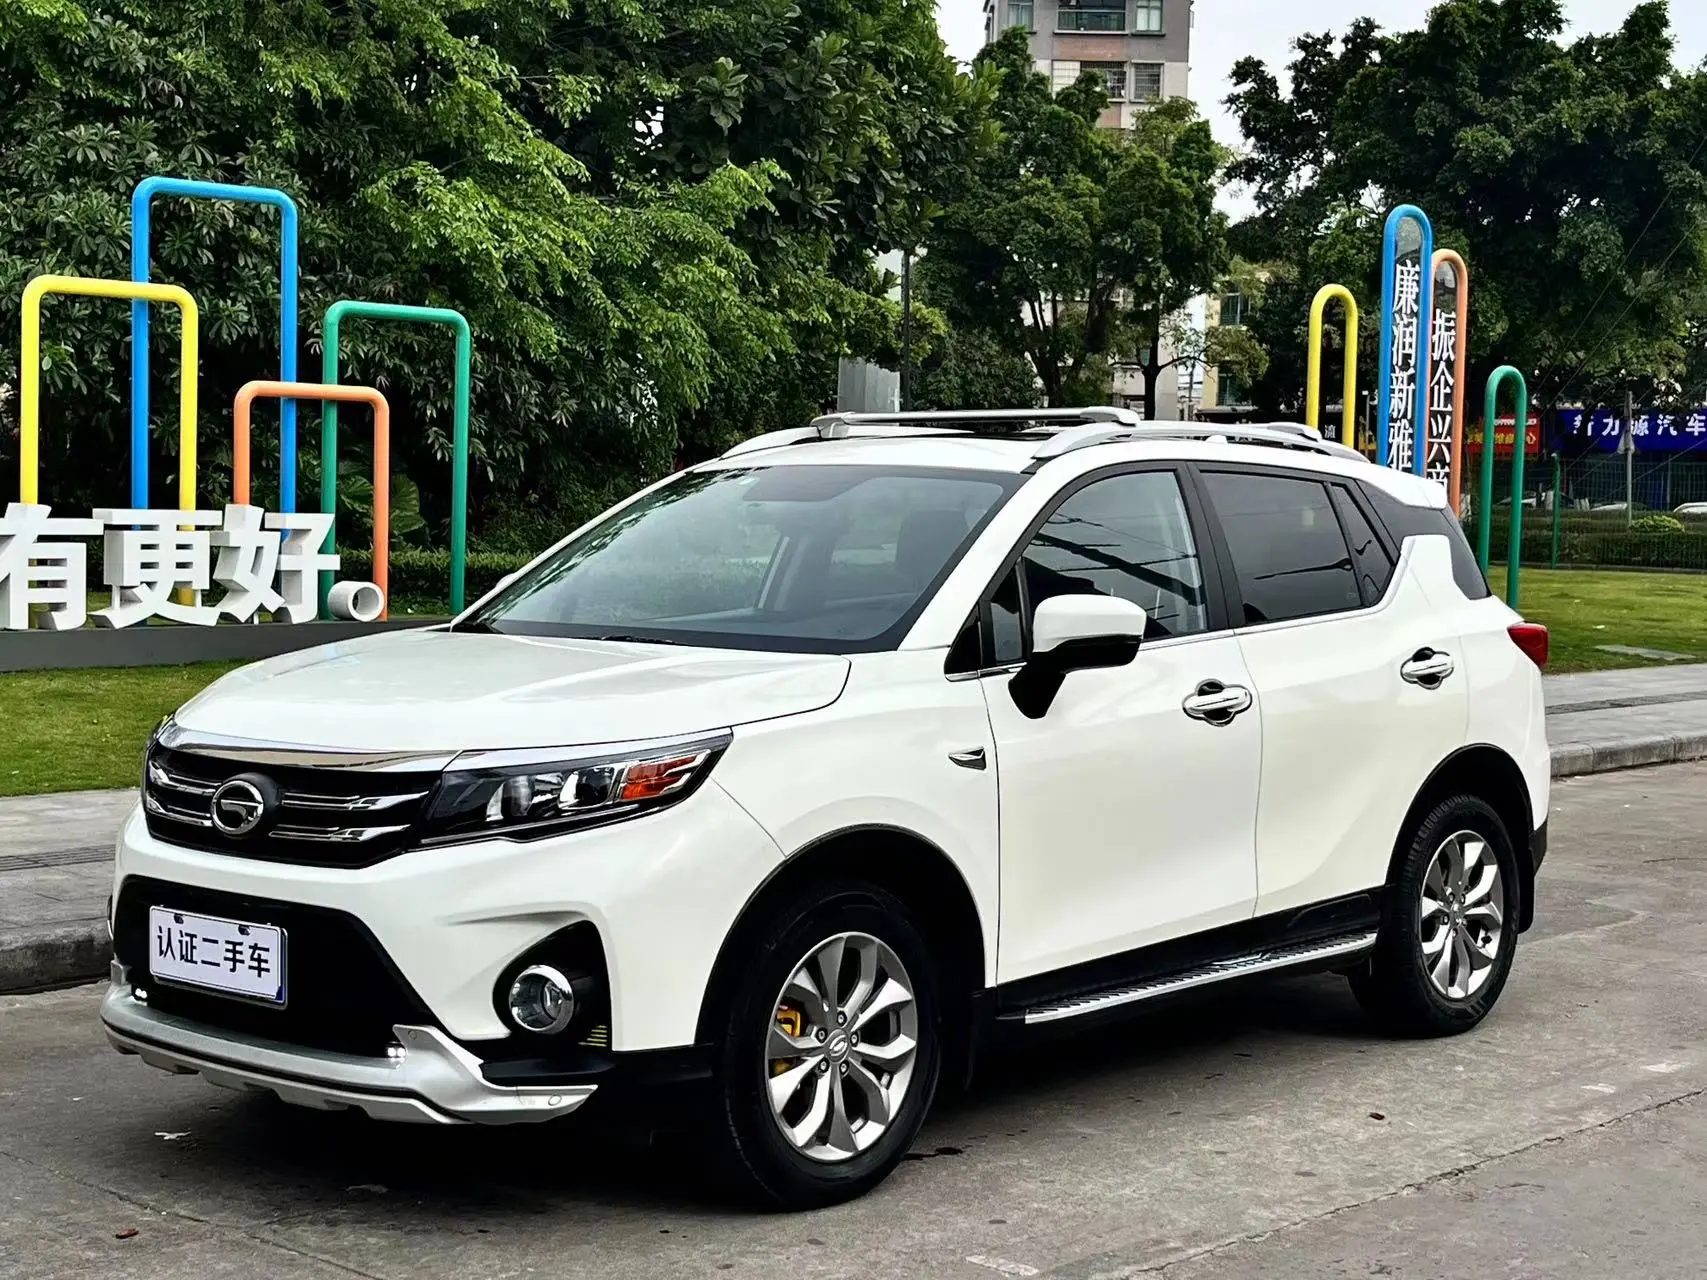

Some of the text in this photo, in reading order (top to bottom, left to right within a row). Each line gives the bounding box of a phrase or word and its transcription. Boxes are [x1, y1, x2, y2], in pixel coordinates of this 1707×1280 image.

[1387, 259, 1420, 472] 廉润新雅
[157, 925, 271, 978] 认证二手车
